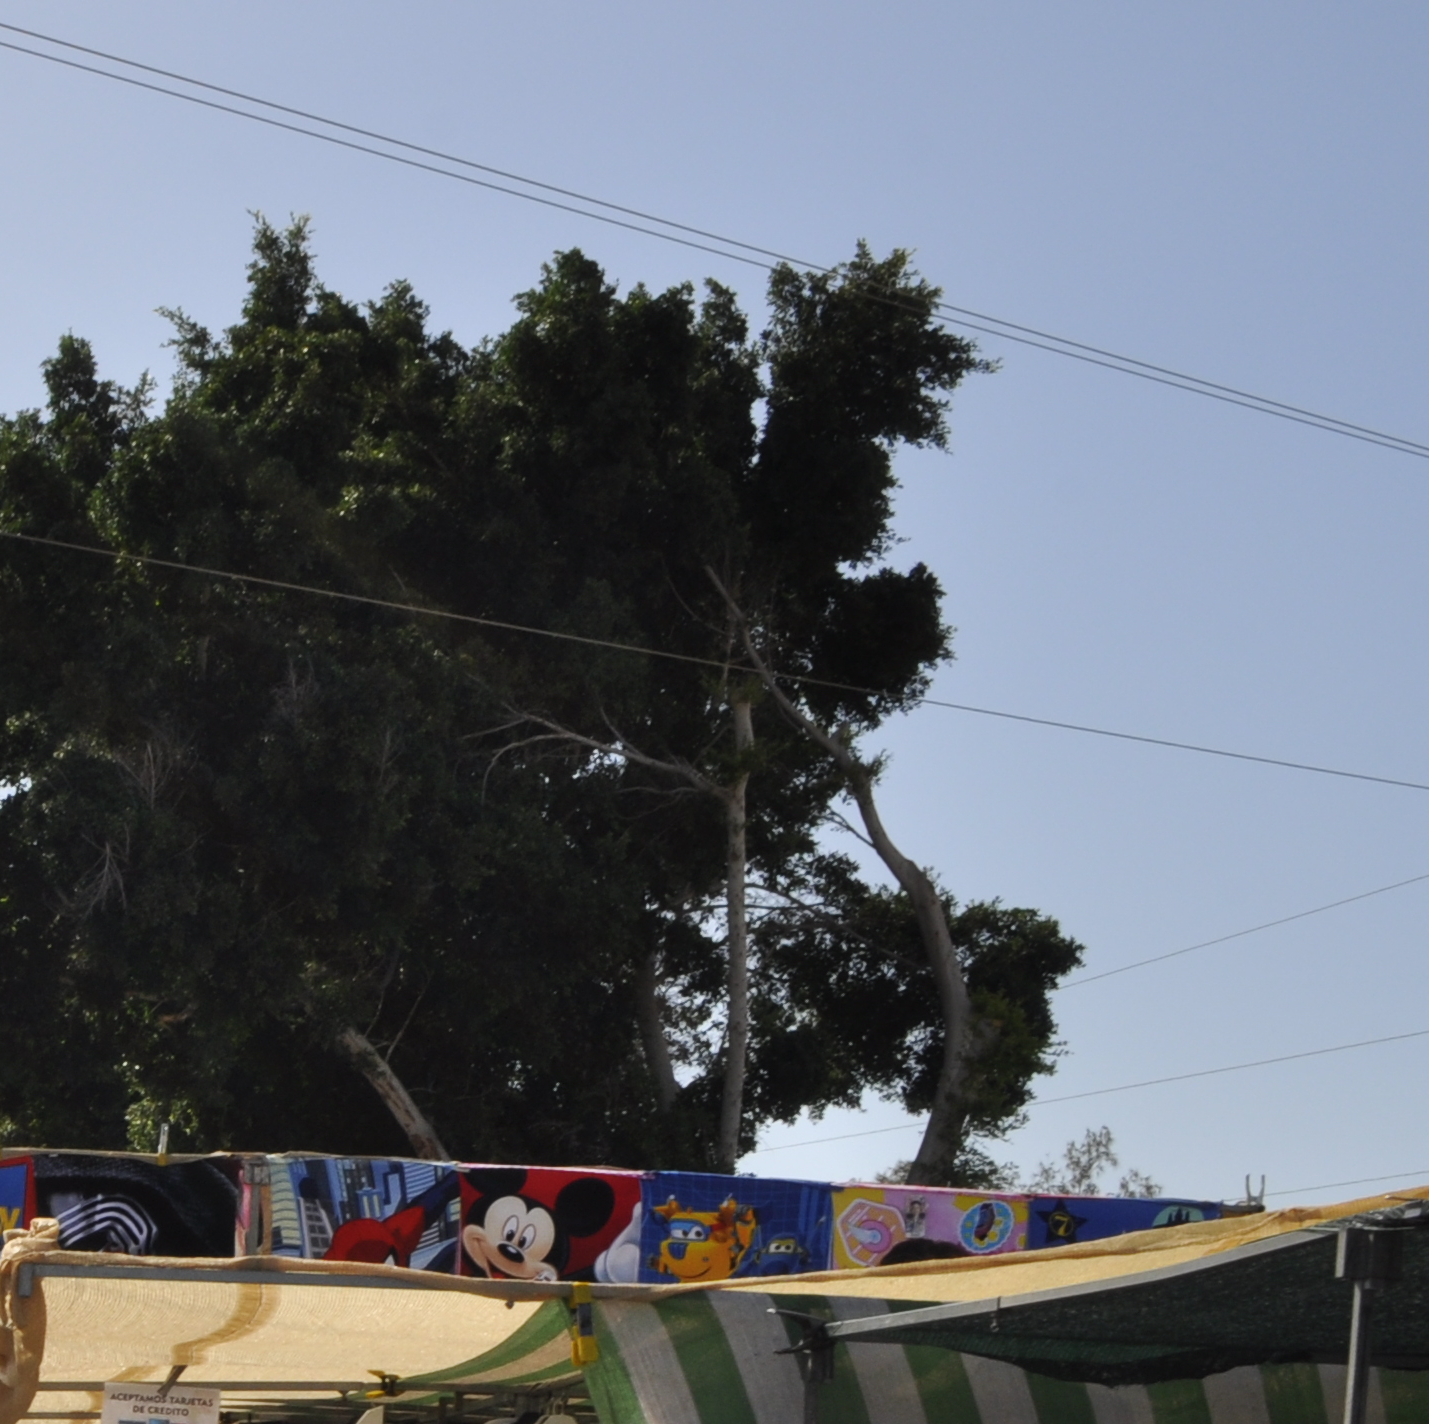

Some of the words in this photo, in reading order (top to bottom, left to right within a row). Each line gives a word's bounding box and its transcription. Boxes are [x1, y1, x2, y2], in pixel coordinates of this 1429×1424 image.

[110, 1392, 167, 1404] ACEPTAMOS
[168, 1396, 214, 1408] TARJETAS
[132, 1405, 145, 1414] DE
[147, 1406, 190, 1417] CREDITO
